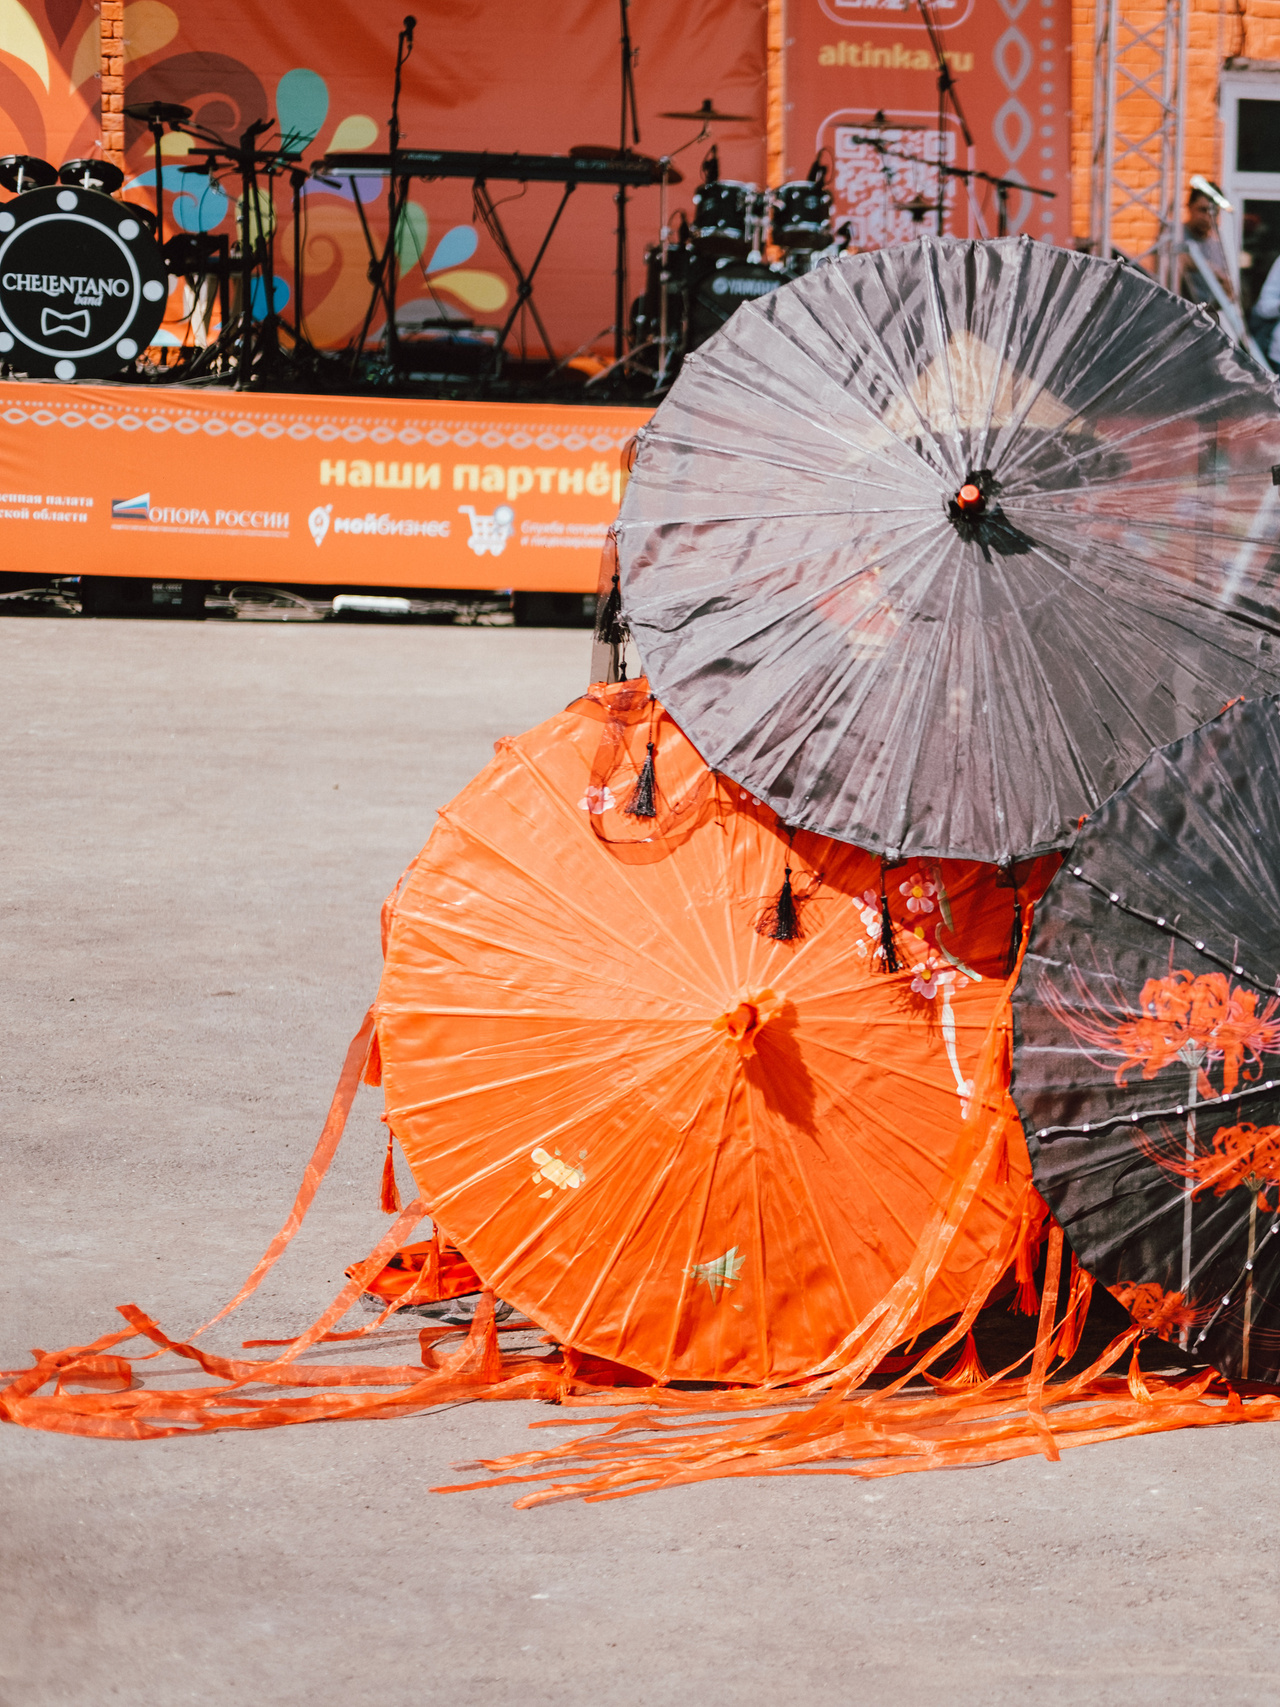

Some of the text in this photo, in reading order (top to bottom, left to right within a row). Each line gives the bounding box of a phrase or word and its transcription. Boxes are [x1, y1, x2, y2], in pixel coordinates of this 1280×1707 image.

[818, 40, 974, 72] altinka.ru
[2, 272, 130, 298] CHELENTANO
[74, 292, 104, 307] band
[319, 458, 441, 491] наши
[45, 494, 94, 508] палата
[32, 507, 88, 523] области
[149, 506, 290, 530] ОПОРА РОССИИ
